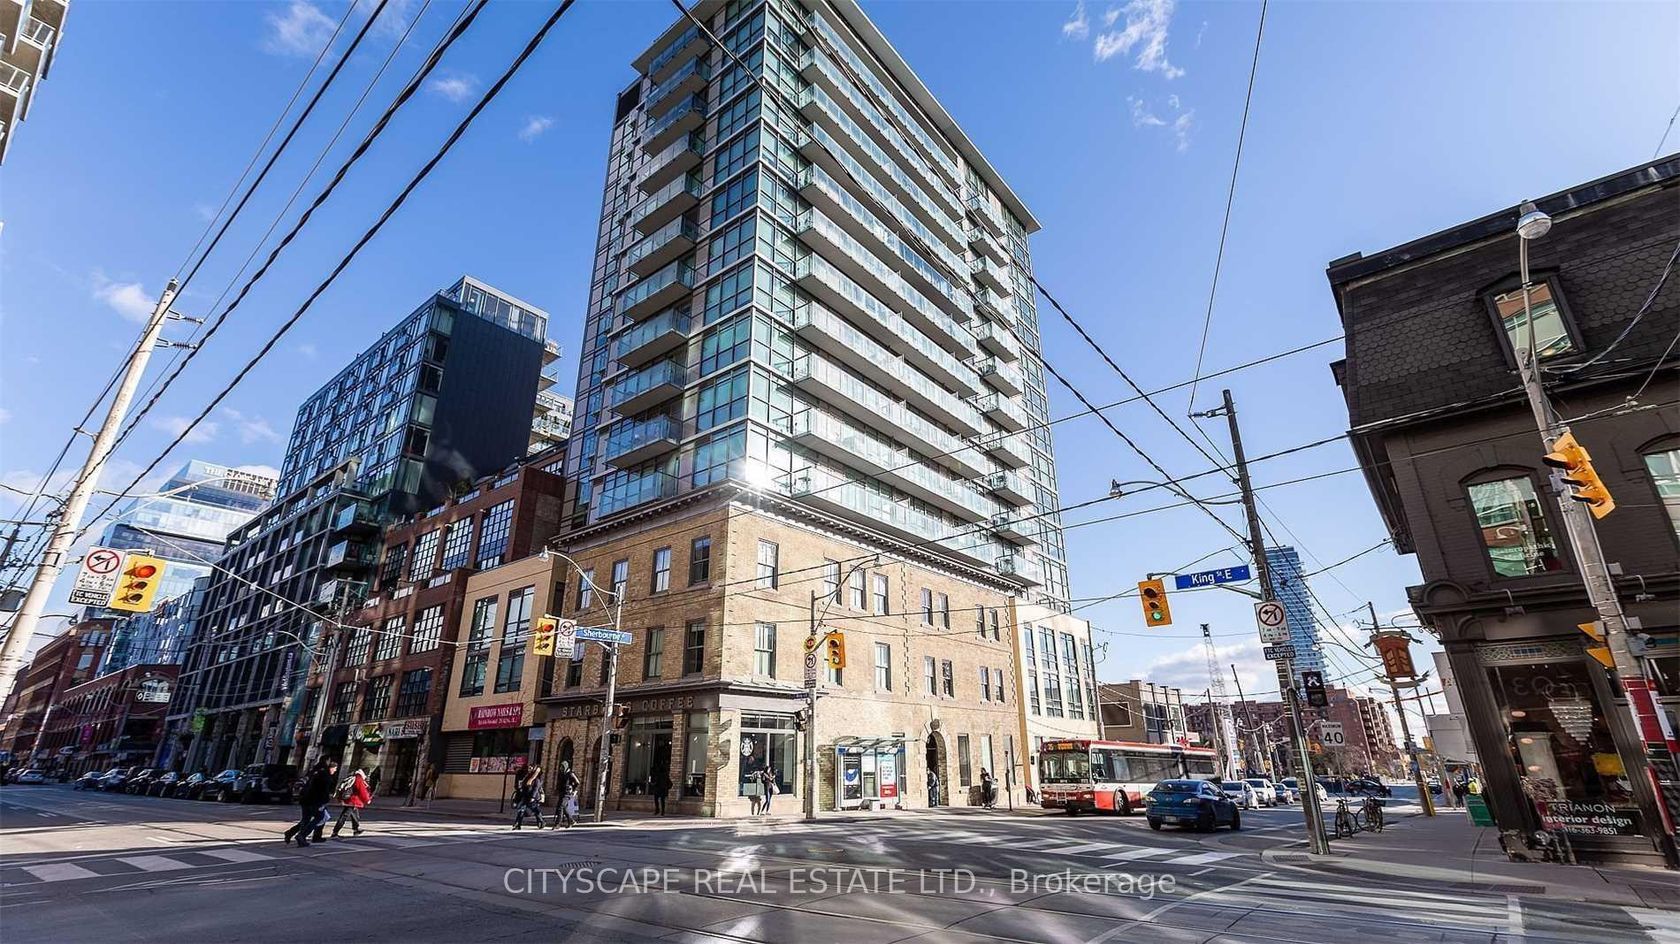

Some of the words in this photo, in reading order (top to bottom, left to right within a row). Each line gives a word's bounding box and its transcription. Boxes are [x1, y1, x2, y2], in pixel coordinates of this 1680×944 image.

[1191, 573, 1215, 585] King
[1225, 569, 1233, 579] E
[562, 702, 632, 717] STARBS
[642, 696, 694, 711] COFFEE
[1325, 732, 1344, 744] 40
[1548, 803, 1616, 813] TRIANON
[1592, 815, 1633, 827] design
